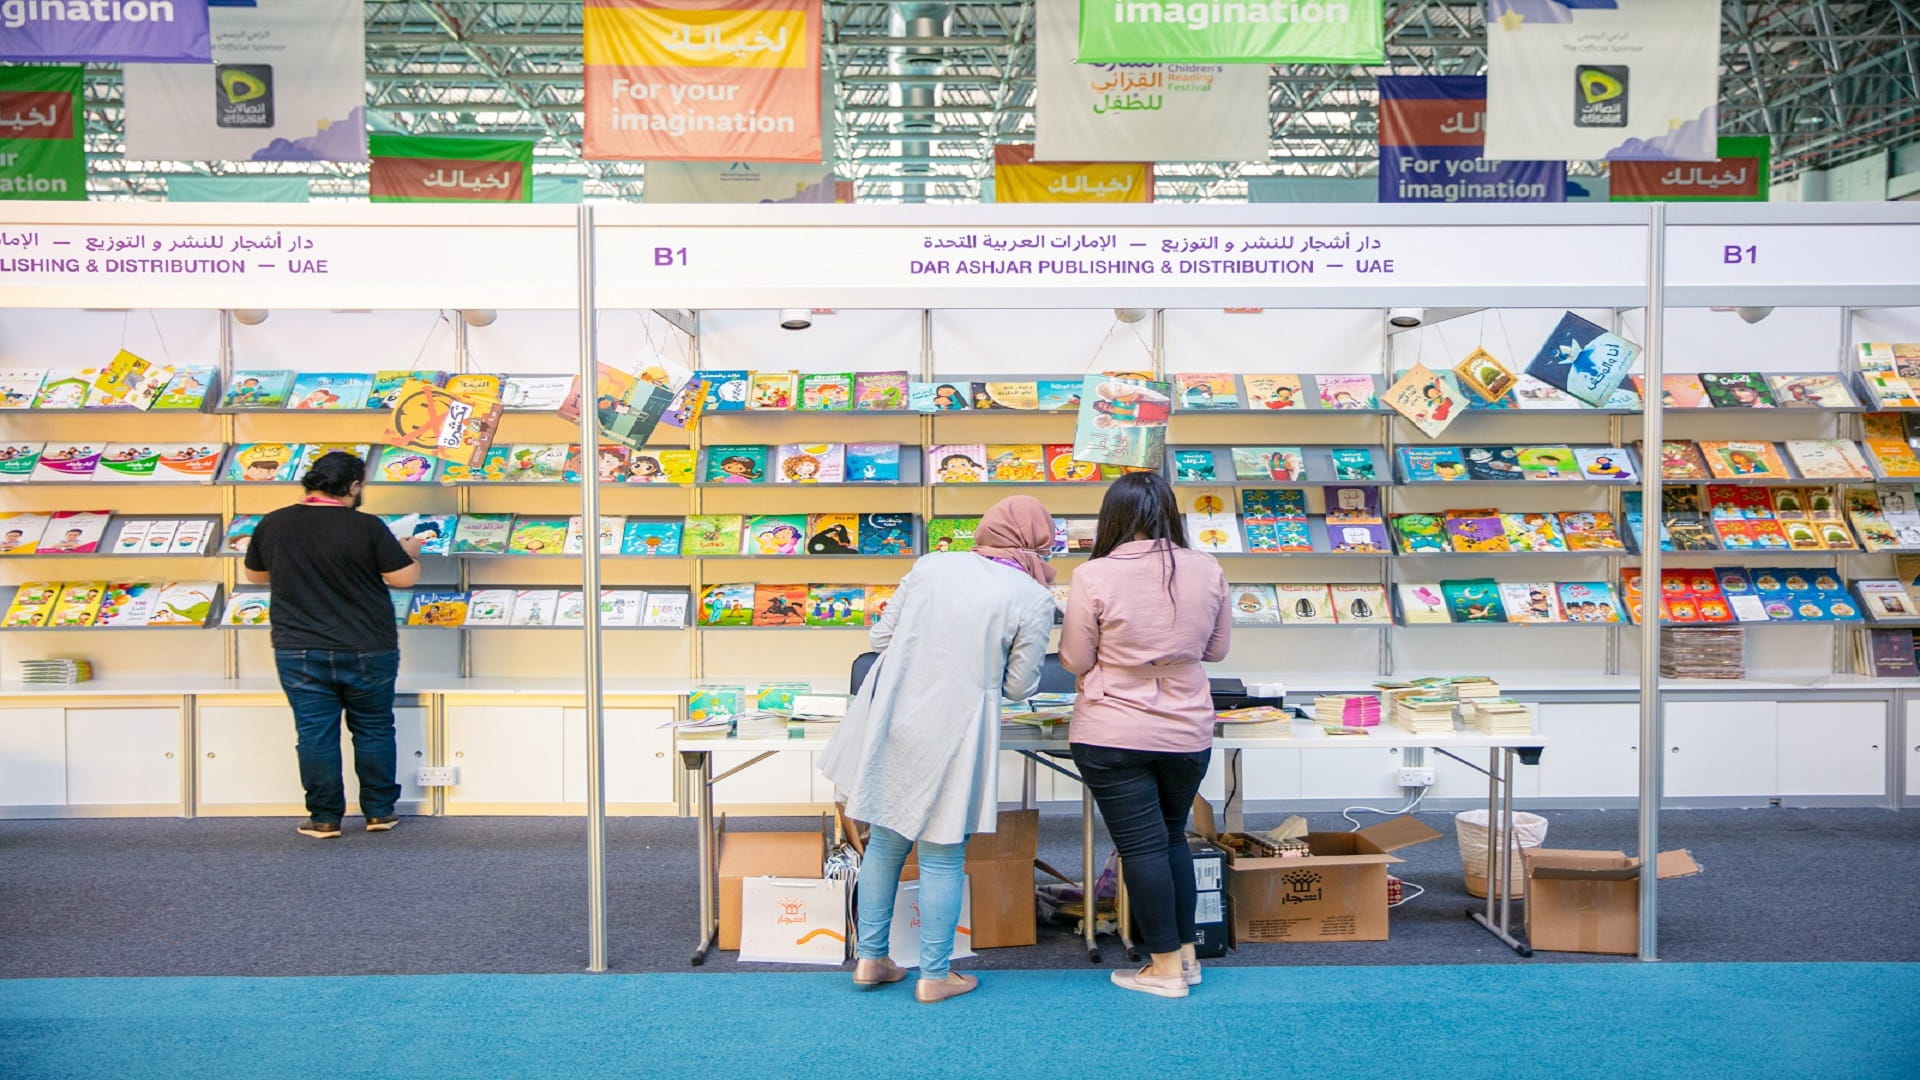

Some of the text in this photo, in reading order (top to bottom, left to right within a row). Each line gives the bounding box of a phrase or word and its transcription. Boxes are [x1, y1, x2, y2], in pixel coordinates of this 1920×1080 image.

[0, 0, 174, 28] gination
[1115, 0, 1348, 30] imagination
[661, 26, 786, 57] لخيالك
[1168, 74, 1214, 84] Reading
[1168, 84, 1212, 92] Festival
[612, 79, 740, 105] For your
[0, 104, 57, 131] لخي
[611, 108, 795, 137] imagination
[1400, 157, 1502, 177] For your
[421, 168, 511, 192] لخيالك
[1047, 174, 1133, 195] لخيالك
[1660, 168, 1747, 188] لخيالك
[1399, 179, 1546, 202] imagination
[0, 232, 39, 250] الإما
[85, 235, 146, 252] التوزيع
[152, 240, 162, 251] و
[168, 235, 224, 252] للنشر
[230, 231, 282, 252] أشجار
[288, 235, 314, 252] دار
[983, 234, 1045, 251] العربية
[1050, 234, 1116, 252] الإمارات
[1161, 236, 1218, 253] التوزيع
[1224, 240, 1235, 252] و
[1240, 236, 1295, 252] للنشر
[1299, 232, 1350, 252] أشجار
[1355, 235, 1382, 252] دار
[653, 247, 689, 267] B1
[1723, 245, 1757, 264] B1
[0, 258, 80, 272] LISHING
[86, 258, 99, 273] &
[105, 259, 245, 274] DISTRIBUTION
[288, 260, 329, 274] UAE
[910, 260, 950, 274] DAR
[956, 260, 1032, 274] ASHJAR
[1038, 260, 1155, 274] PUBLISHING
[1161, 260, 1173, 273] &
[1179, 260, 1314, 274] DISTRIBUTION
[1356, 259, 1395, 273] UAE
